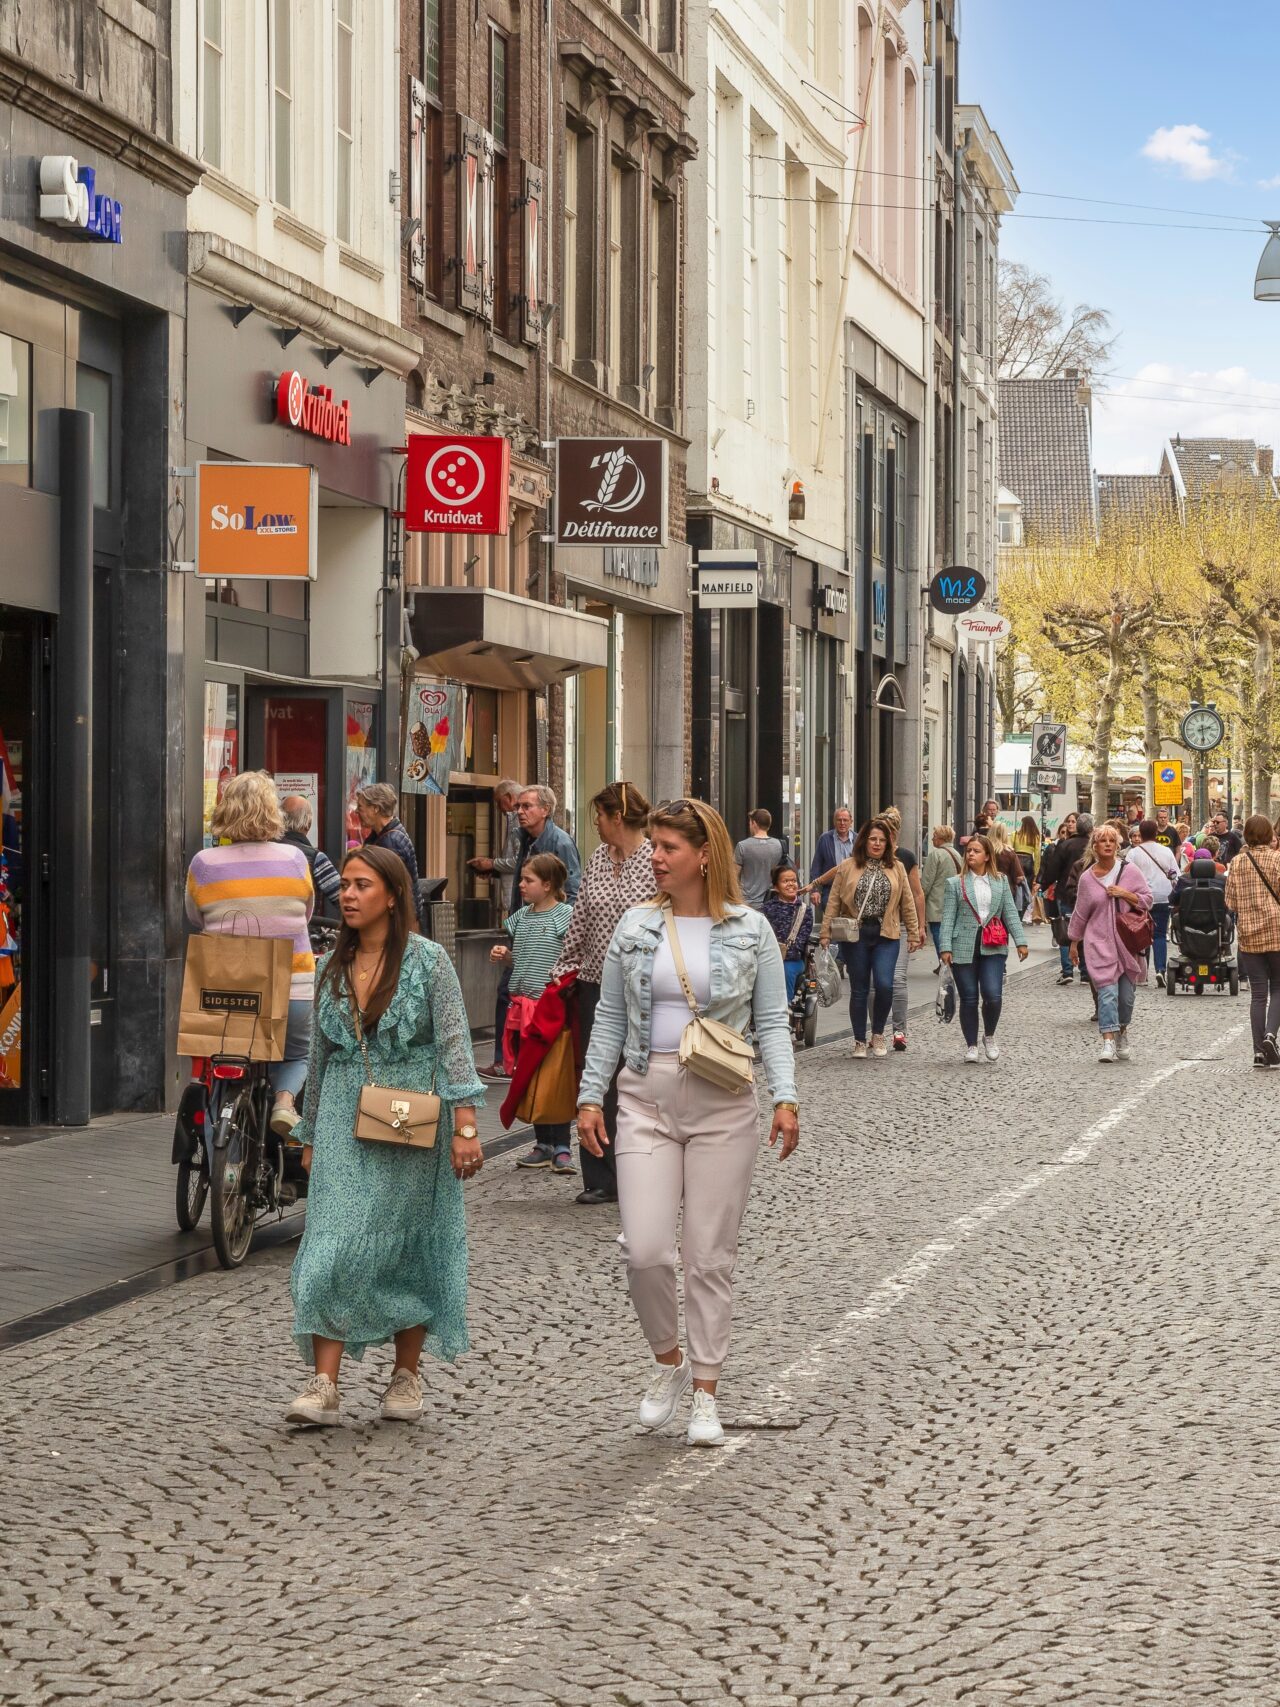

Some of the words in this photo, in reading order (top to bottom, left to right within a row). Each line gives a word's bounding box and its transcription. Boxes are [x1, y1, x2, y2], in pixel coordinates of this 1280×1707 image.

[424, 509, 483, 525] Kruidvat
[562, 521, 658, 538] Délifrance
[702, 583, 753, 592] MANFIELD
[962, 620, 1003, 636] Triumph
[205, 997, 256, 1006] SIDESTEP
